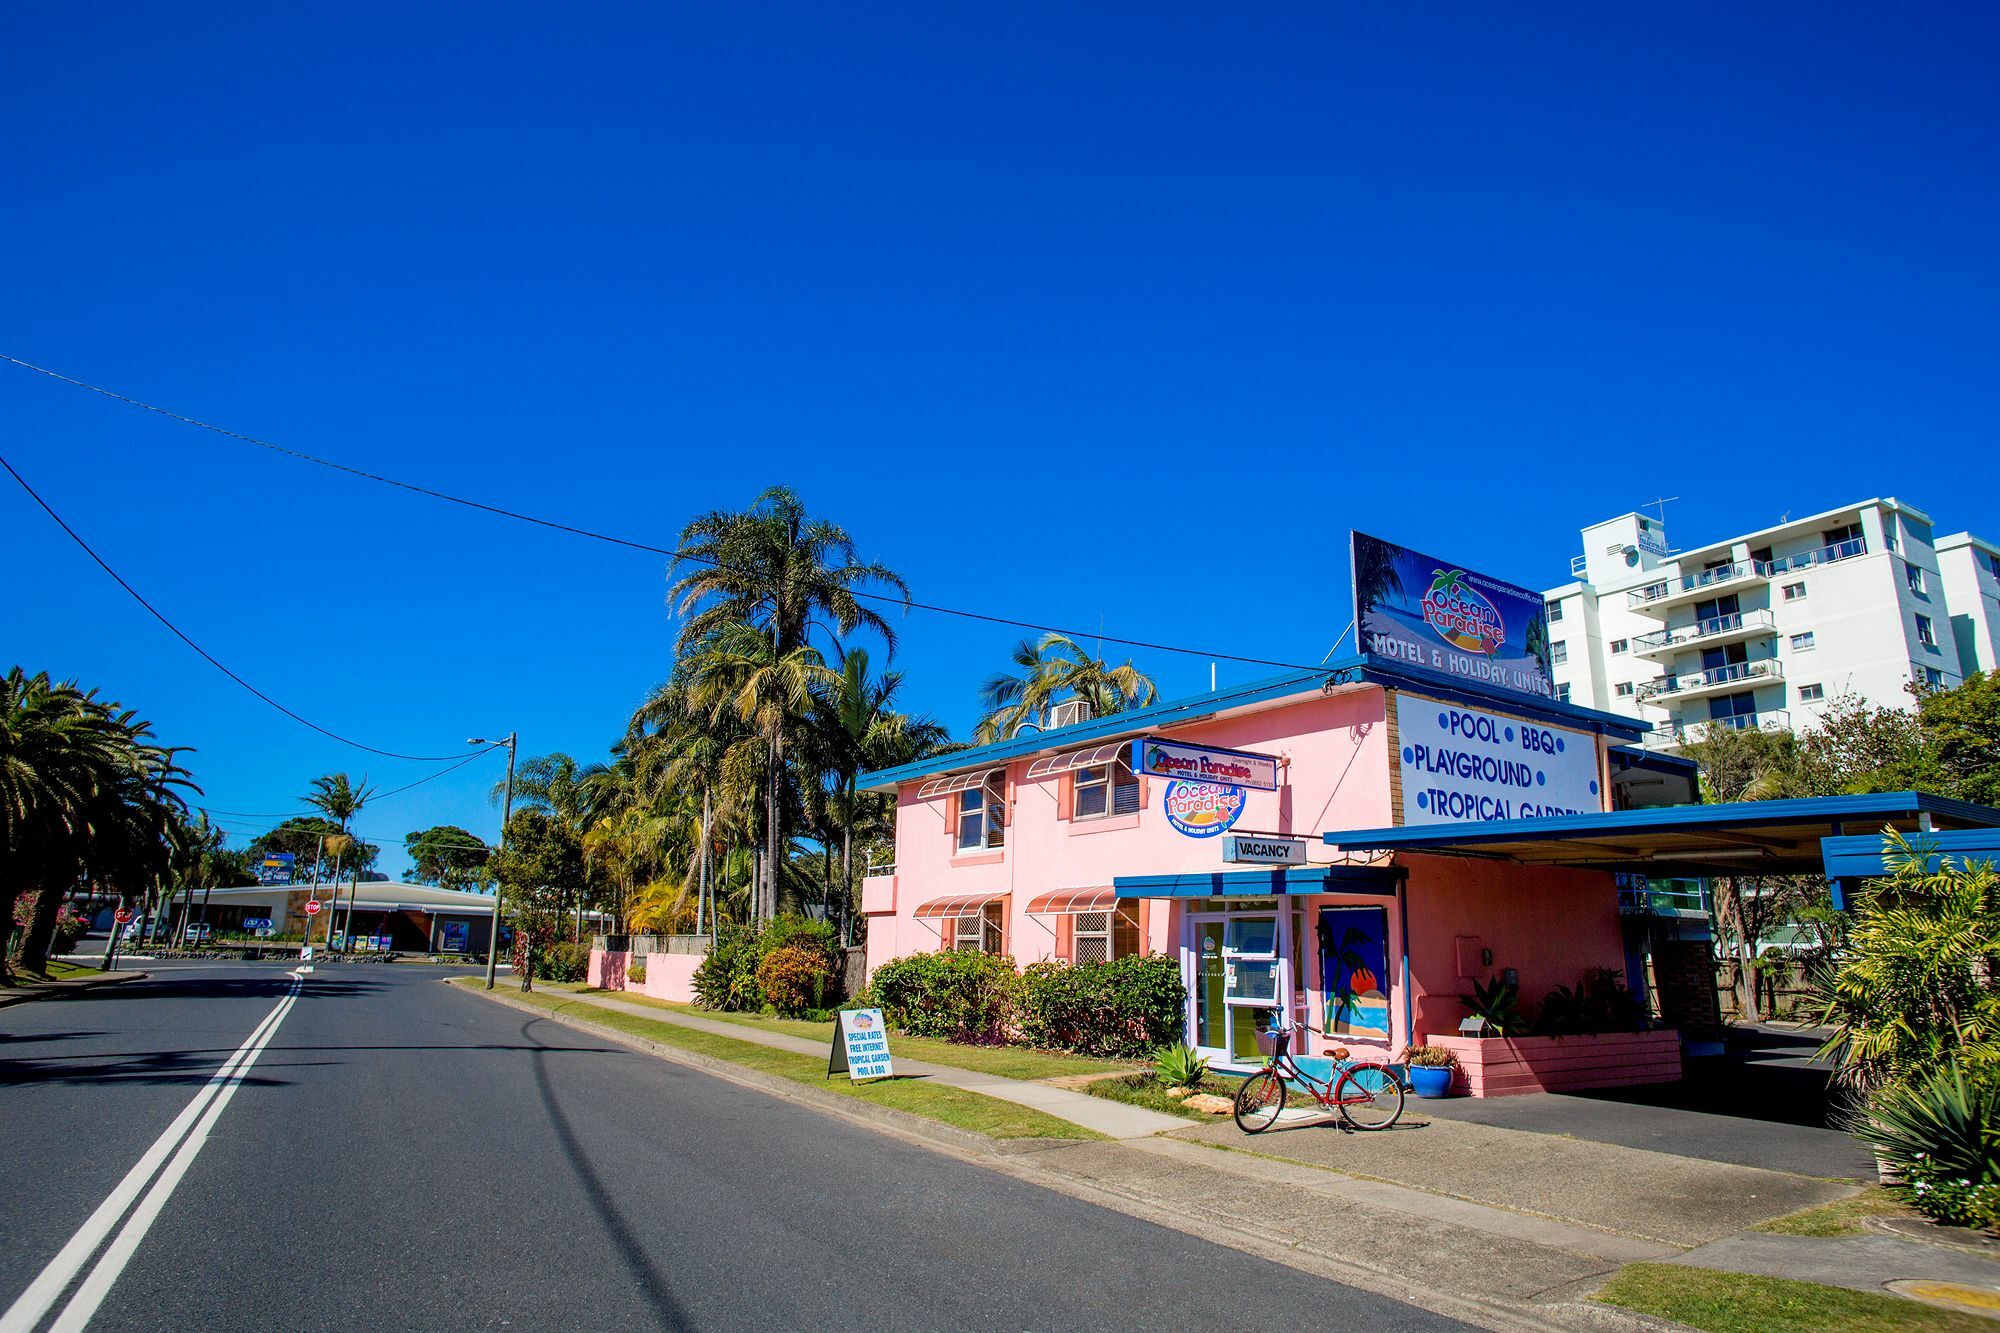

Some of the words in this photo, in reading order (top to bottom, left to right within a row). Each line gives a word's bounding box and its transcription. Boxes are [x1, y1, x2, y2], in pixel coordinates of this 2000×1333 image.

[1468, 575, 1542, 605] www.oceanparadisecoffs.com
[1432, 591, 1495, 624] Ocean
[1420, 600, 1506, 643] Paradise
[1373, 633, 1425, 664] MOTEL
[1431, 649, 1442, 668] &
[1449, 653, 1508, 687] HOLIDAY
[1512, 670, 1550, 695] UNITS
[1449, 710, 1500, 744] POOL
[1520, 725, 1556, 756] BBQ
[1156, 753, 1198, 772] Ocean
[1199, 755, 1252, 779] Paradise
[1414, 743, 1532, 788] PLAYGROUND
[1199, 773, 1218, 781] HOLIDAY
[1176, 784, 1232, 799] Ocean
[1167, 795, 1241, 815] Paradise
[1427, 787, 1510, 821] TROPICAL
[1172, 818, 1185, 831] MOTEL
[1239, 842, 1290, 858] VACANCY
[848, 1031, 867, 1042] SPECIAL
[867, 1030, 882, 1040] RATES
[850, 1044, 862, 1053] FREE
[862, 1042, 884, 1052] INTERNET
[848, 1055, 870, 1064] TROPICAL
[871, 1053, 891, 1063] GARDEN
[857, 1066, 870, 1075] POOL
[870, 1066, 875, 1075] &
[875, 1065, 886, 1074] BBQ
